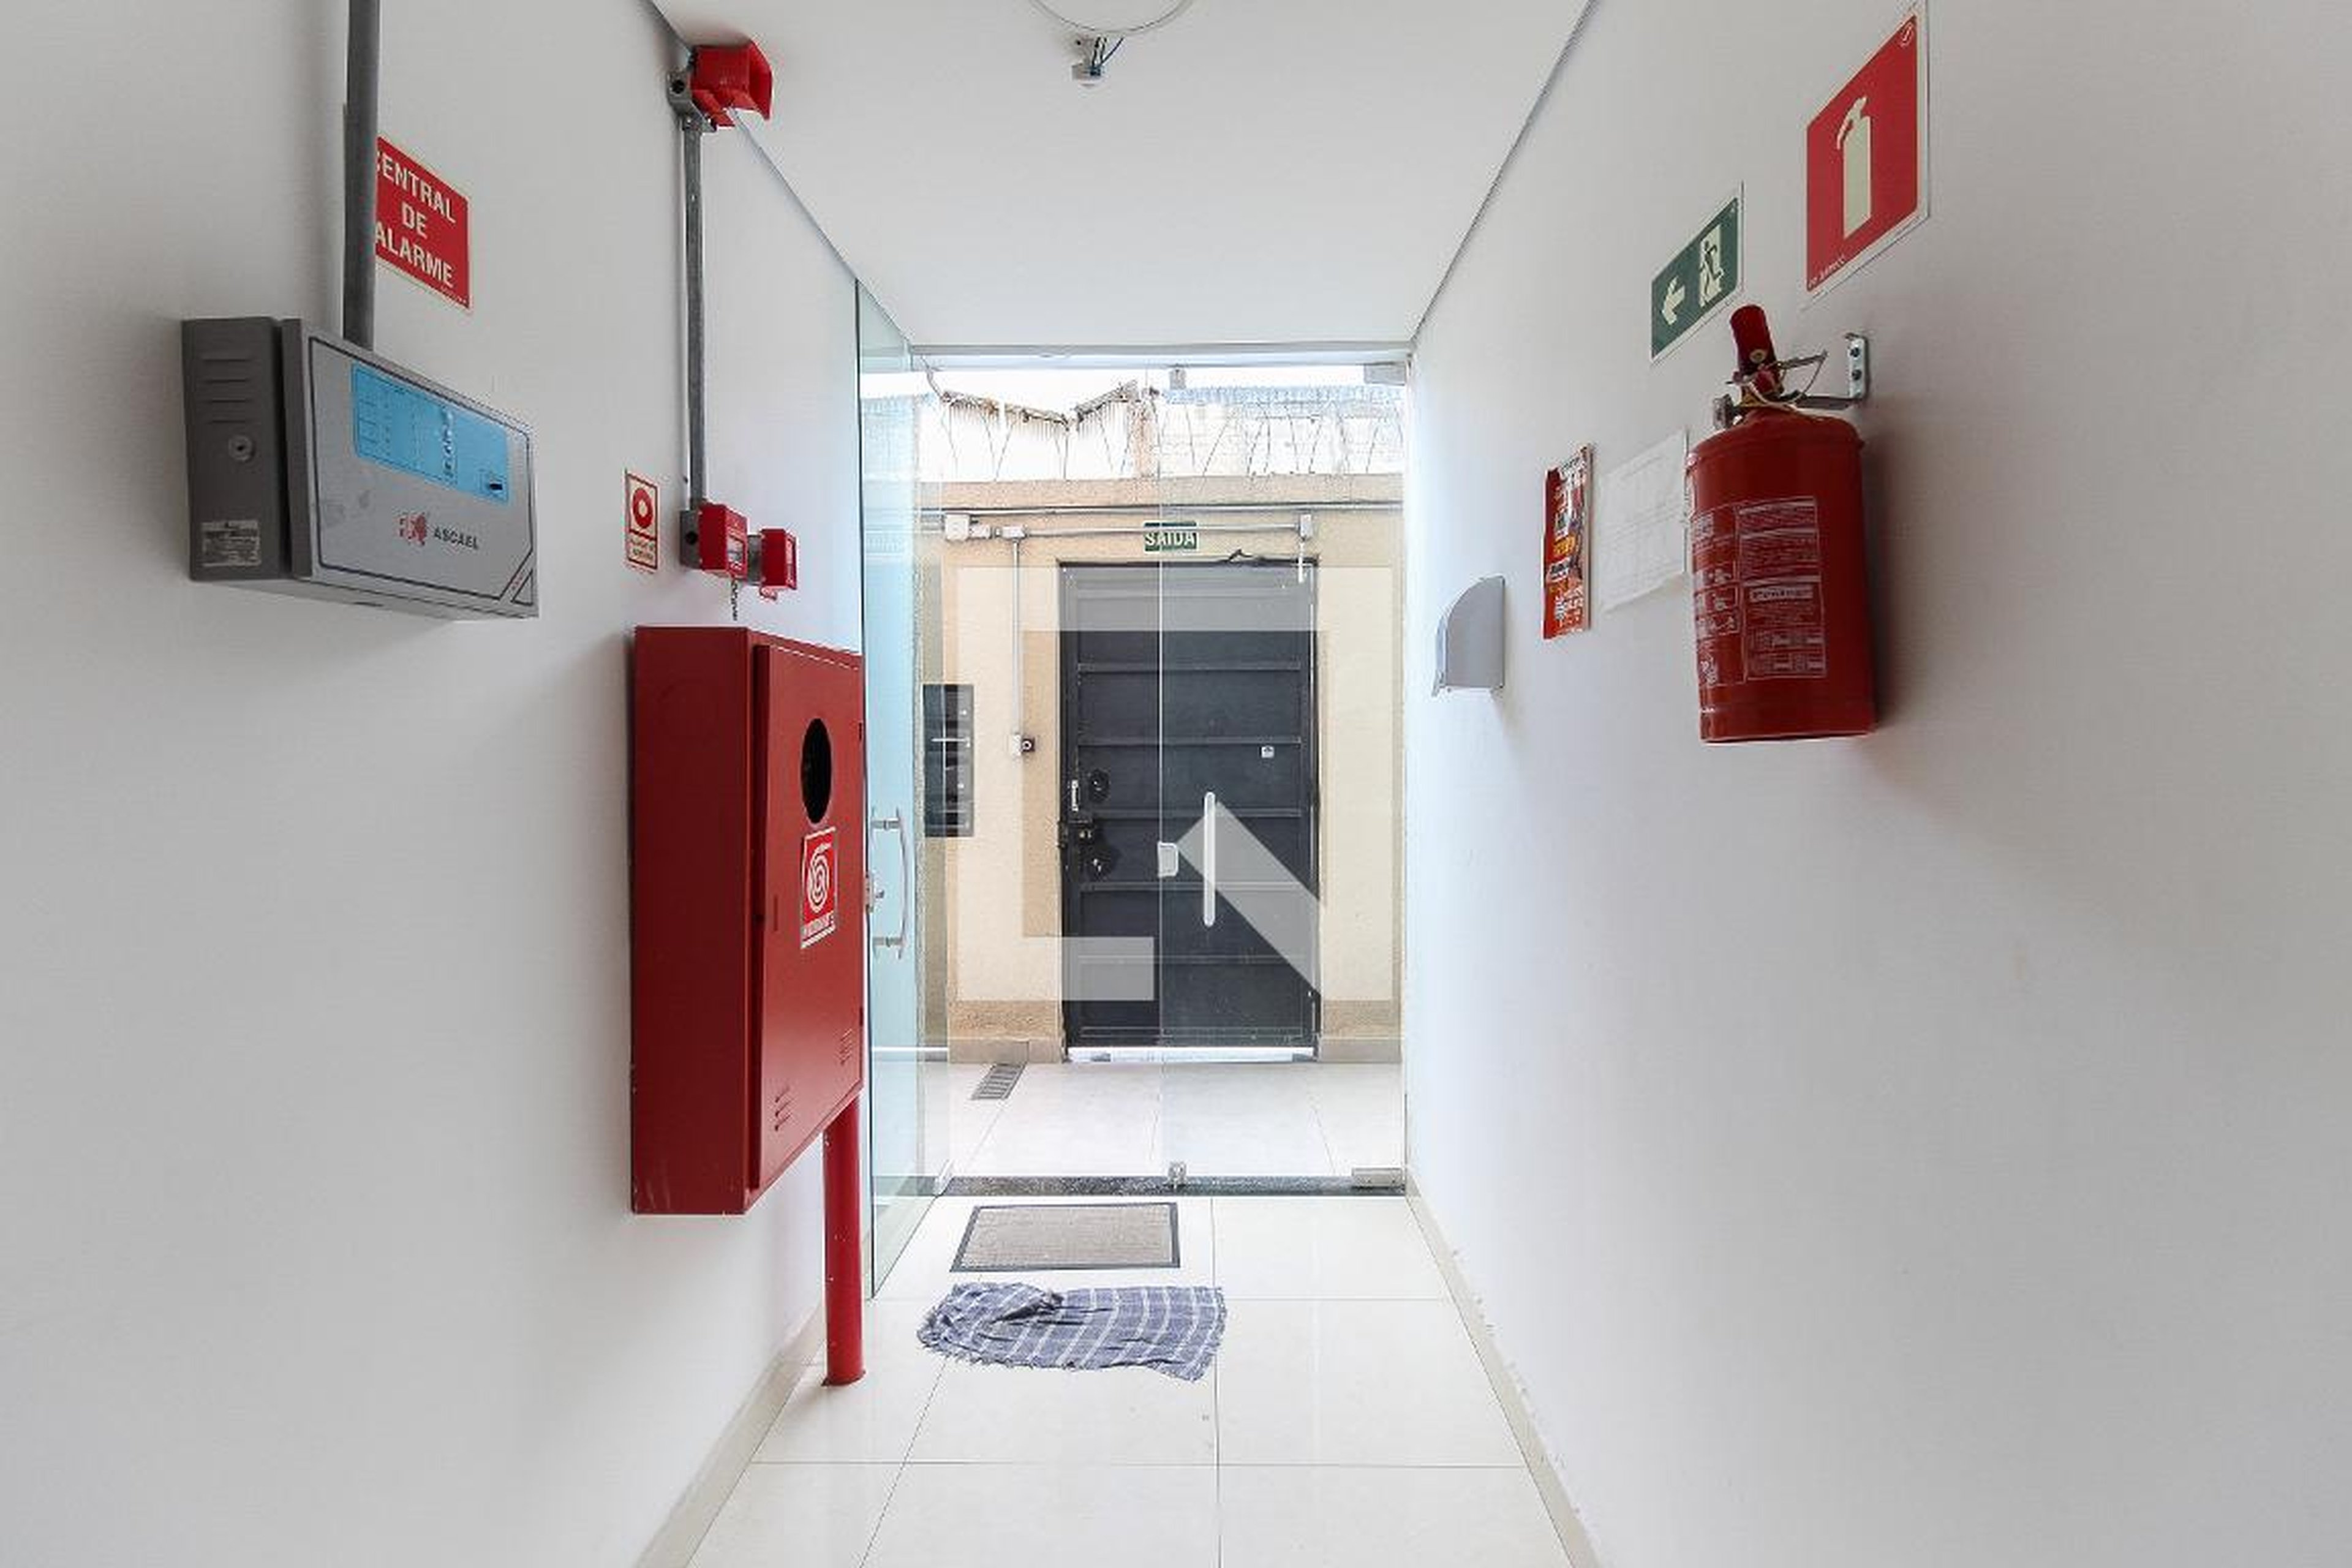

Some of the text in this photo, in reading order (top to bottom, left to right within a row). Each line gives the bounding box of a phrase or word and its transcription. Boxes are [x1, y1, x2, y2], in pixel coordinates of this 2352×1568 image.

[402, 202, 428, 239] DE
[375, 221, 453, 288] ALARME
[434, 526, 478, 549] ASCAEL
